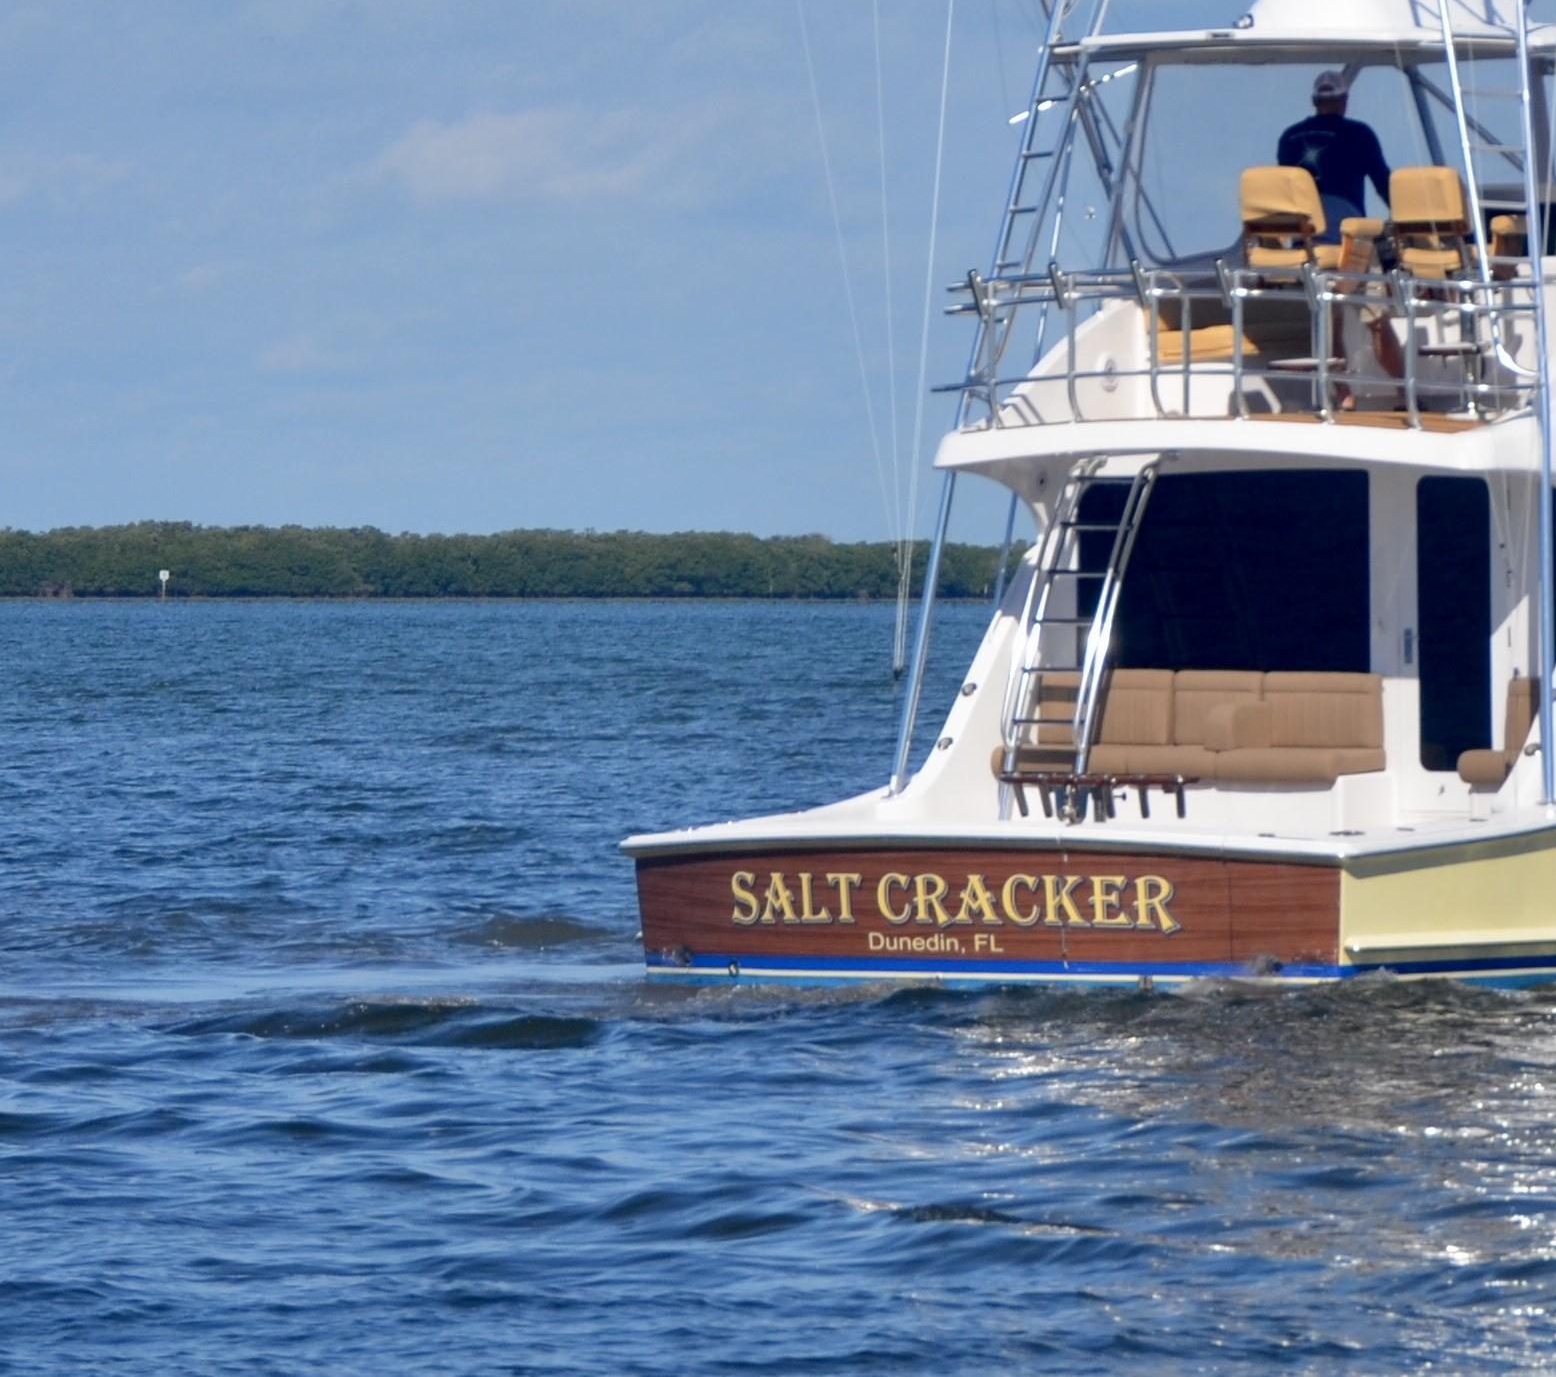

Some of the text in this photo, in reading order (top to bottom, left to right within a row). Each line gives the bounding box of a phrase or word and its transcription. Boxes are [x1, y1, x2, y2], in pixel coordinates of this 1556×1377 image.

[731, 871, 1181, 935] SALT CRACKER
[868, 932, 1004, 954] Dunedin, FL
